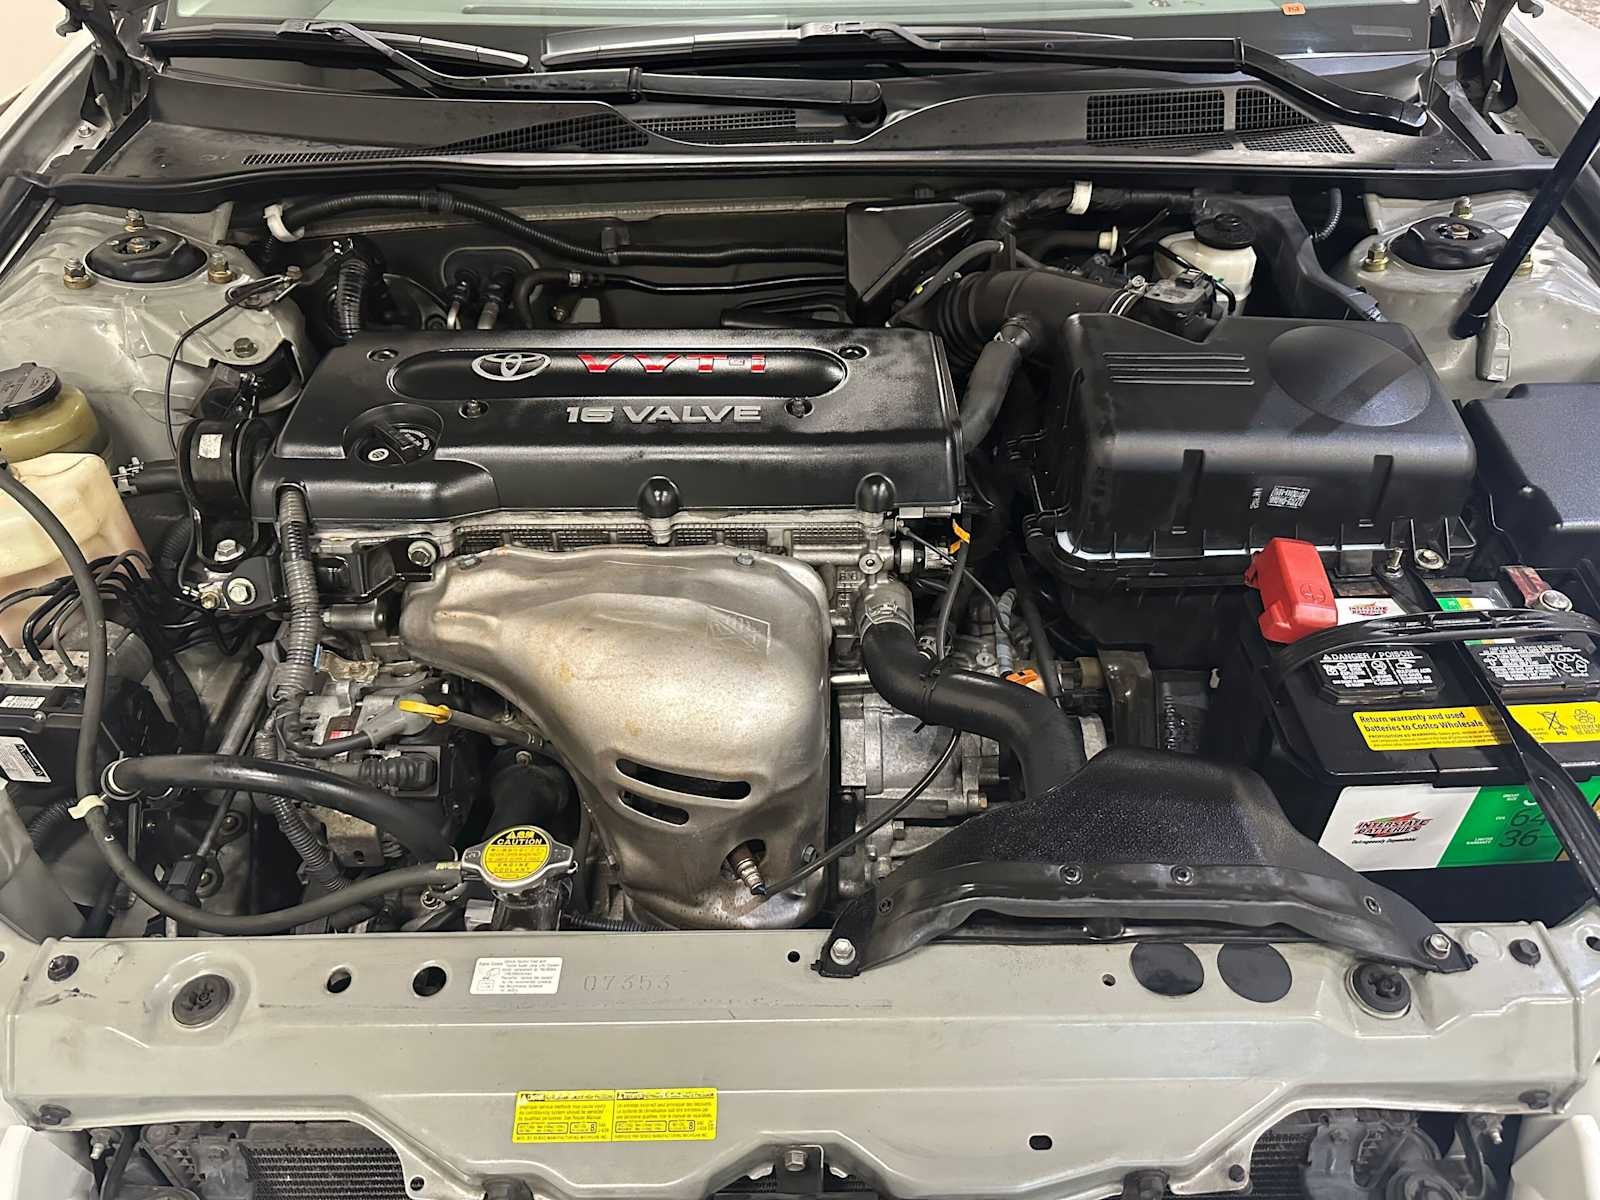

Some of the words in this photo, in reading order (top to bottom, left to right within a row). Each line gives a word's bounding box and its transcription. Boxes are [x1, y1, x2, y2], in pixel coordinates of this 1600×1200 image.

[566, 405, 615, 424] 16
[622, 405, 762, 424] VALVE
[1331, 652, 1370, 660] DANGER
[1379, 650, 1415, 659] POISON
[1360, 715, 1388, 723] Return
[1390, 713, 1427, 723] warranty
[1428, 712, 1445, 720] and
[1445, 711, 1465, 720] used
[1364, 724, 1401, 732] batteries
[1402, 723, 1411, 731] to
[1412, 722, 1439, 731] Costco
[1440, 720, 1484, 730] Wholesale
[1355, 819, 1430, 829] INTERSTATE
[1354, 826, 1421, 835] BATTERIES
